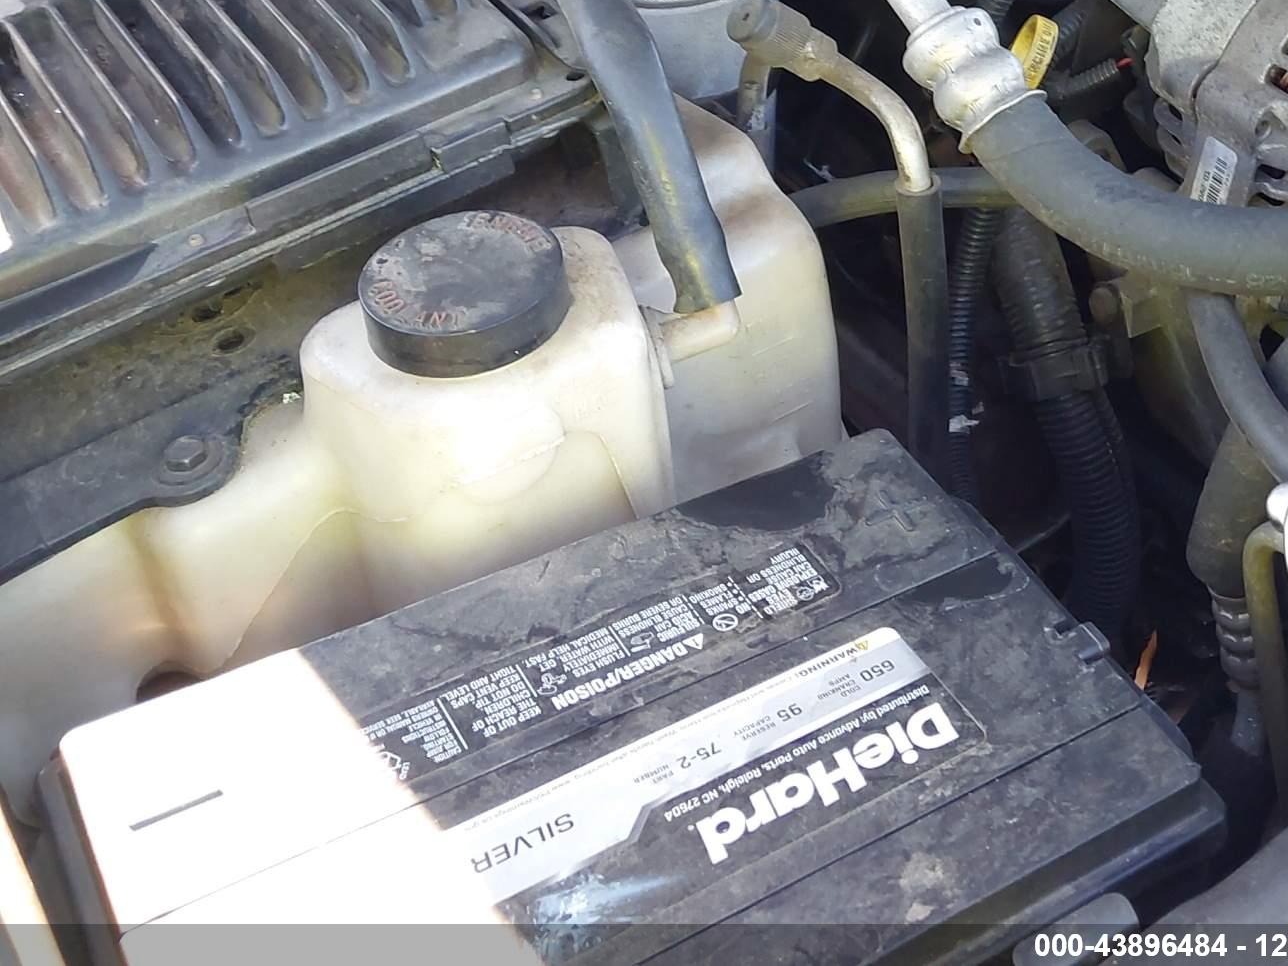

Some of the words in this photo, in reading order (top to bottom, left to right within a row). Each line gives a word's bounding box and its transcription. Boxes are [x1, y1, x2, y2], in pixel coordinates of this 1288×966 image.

[759, 552, 805, 578] BLINDNESS
[745, 572, 760, 583] OR
[638, 600, 670, 619] SEVERE
[660, 602, 688, 619] CAUSE
[763, 595, 798, 616] SHIELD
[611, 613, 641, 630] BURNS
[617, 613, 663, 638] BLINDNESS
[670, 610, 693, 625] ACID
[568, 626, 609, 649] MEDICAL
[656, 617, 700, 642] SULFURIC
[545, 642, 570, 658] HELP
[589, 634, 614, 650] WITH
[537, 658, 557, 672] GET
[561, 641, 619, 672] IMMEDIATELY
[594, 649, 625, 668] FLUSH
[488, 664, 516, 681] TIGHT
[550, 640, 688, 710] DANGER/POISON
[571, 661, 596, 678] EYES
[858, 658, 895, 683] 650
[469, 676, 489, 689] AND
[497, 672, 520, 687] KEEP
[509, 680, 526, 692] DO
[474, 682, 498, 697] VENT
[490, 687, 510, 701] NOT
[449, 692, 475, 708] CAPS
[515, 696, 536, 711] THE
[875, 684, 930, 717] Distributed
[483, 705, 517, 725] REACH
[516, 705, 542, 722] KEEP
[775, 702, 803, 722] 95
[858, 708, 877, 725] by:
[469, 719, 485, 731] OF
[481, 725, 497, 737] OF
[496, 716, 517, 730] OUT
[816, 718, 861, 745] Advance
[675, 740, 721, 770] 75-2
[791, 738, 819, 758] Auto
[760, 751, 793, 773] Parts,
[716, 765, 762, 795] Raleigh,
[699, 788, 719, 803] NC
[662, 796, 702, 822] 27604
[467, 809, 577, 876] SILVER
